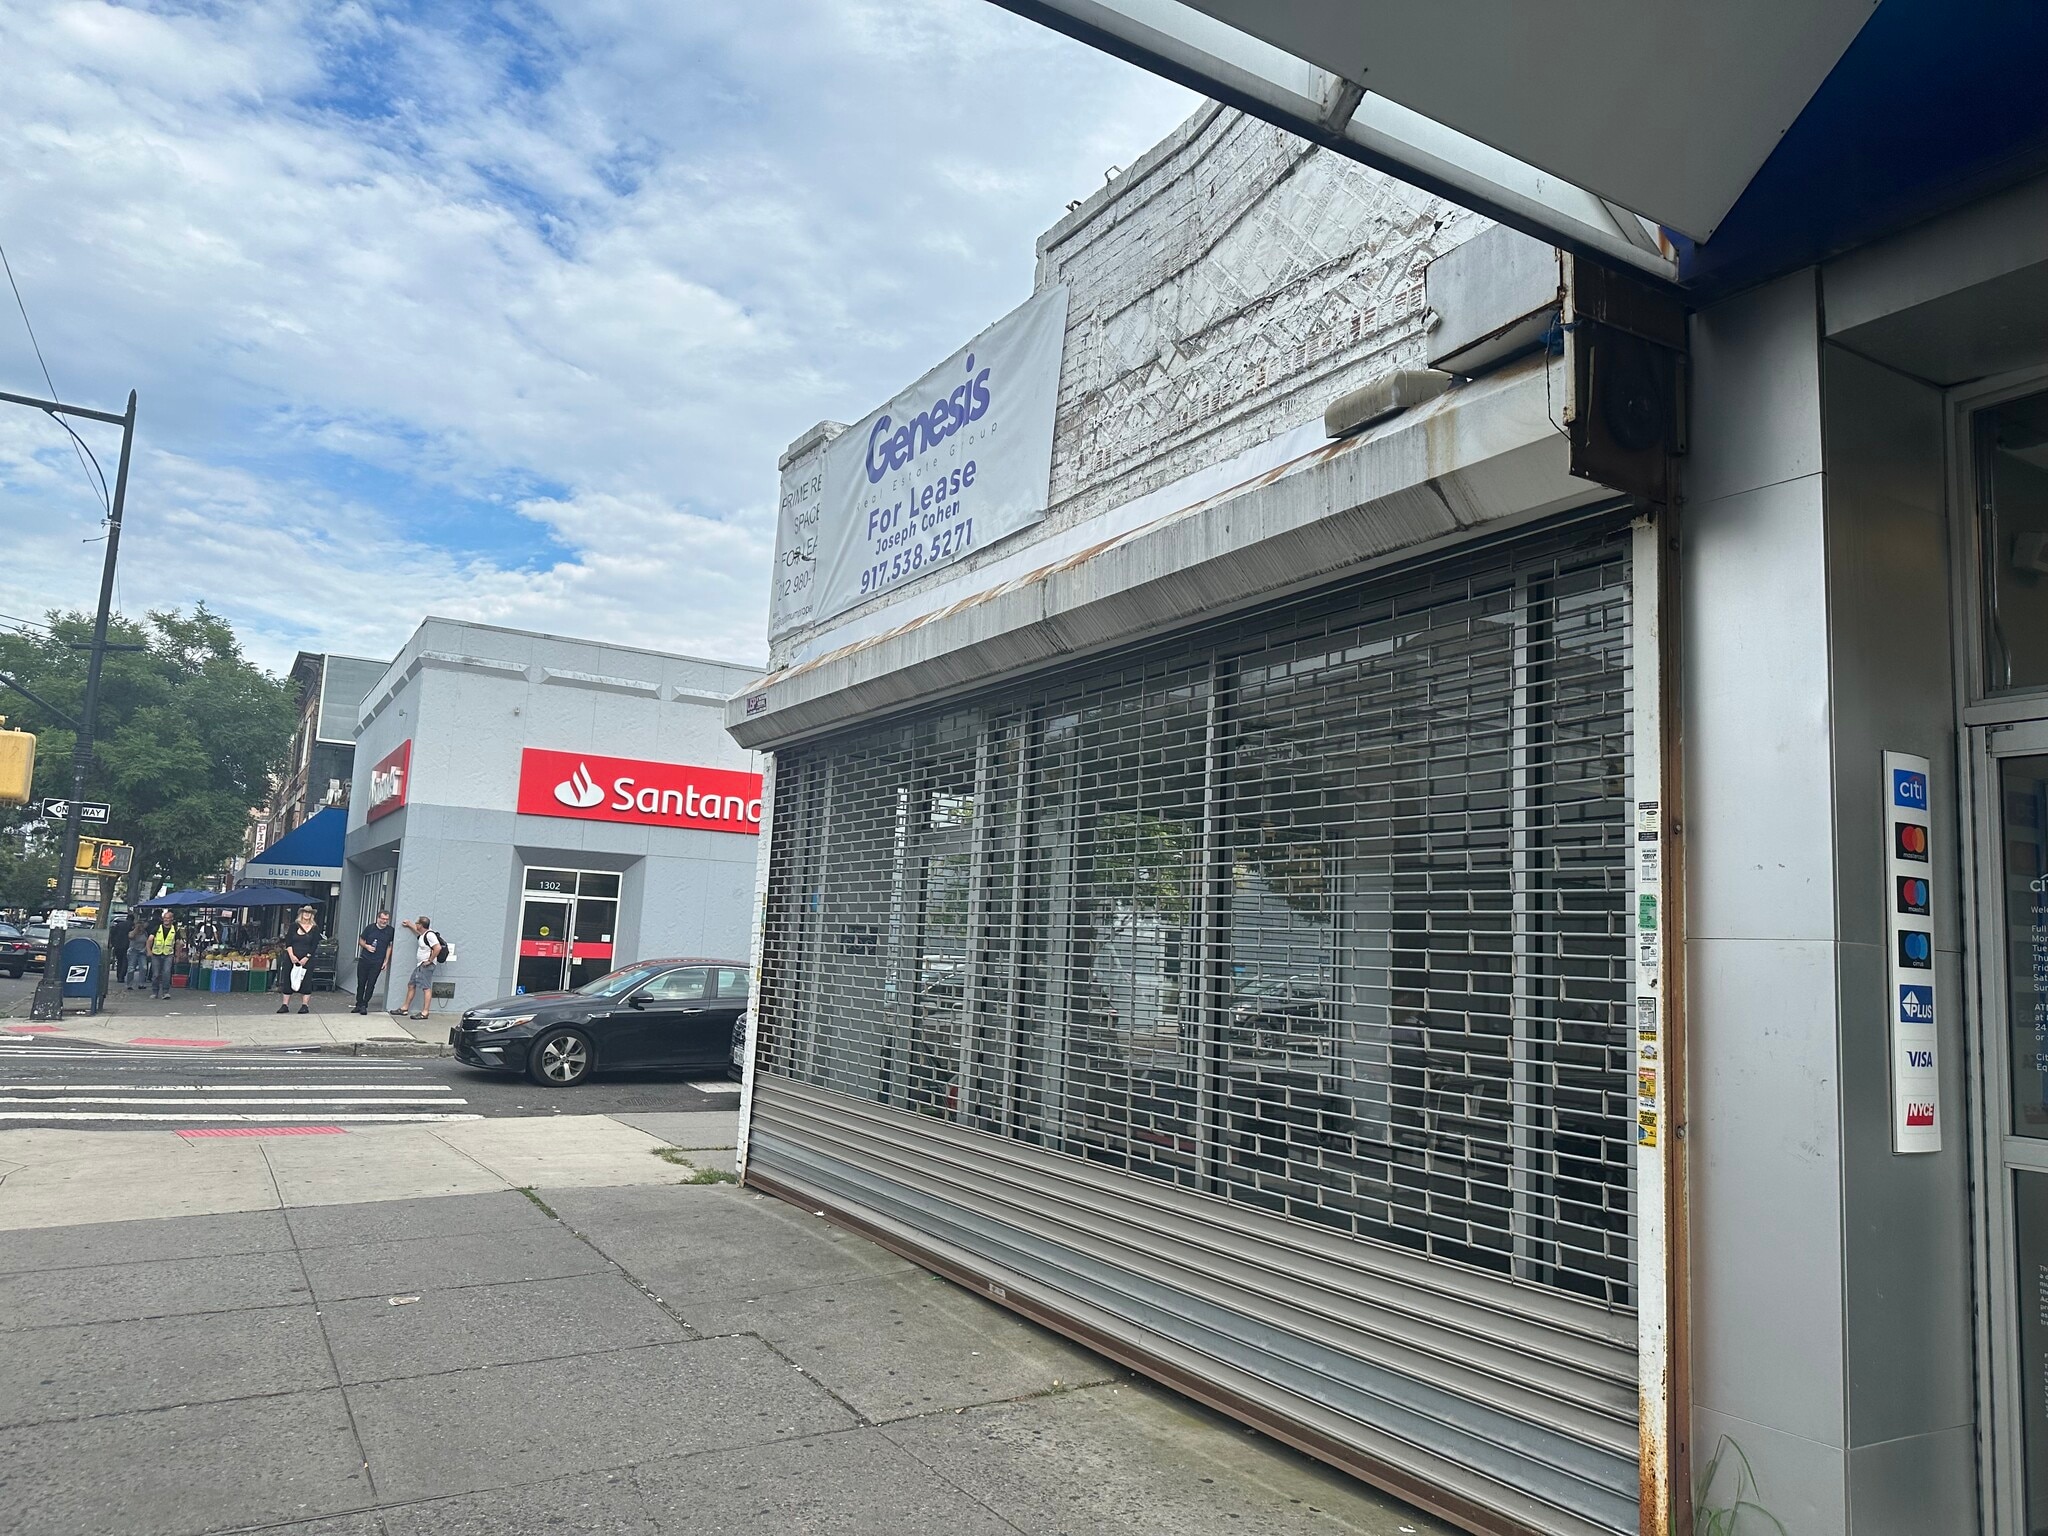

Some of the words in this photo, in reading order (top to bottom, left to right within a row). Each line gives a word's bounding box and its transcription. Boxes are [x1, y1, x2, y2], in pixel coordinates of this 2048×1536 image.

[866, 352, 991, 484] Genesis
[892, 458, 938, 492] Estate
[949, 421, 998, 457] Group
[781, 481, 809, 514] PRIME
[867, 501, 902, 541] For
[909, 460, 977, 519] Lease
[875, 520, 917, 556] Joseph
[921, 500, 960, 531] Cohen
[860, 517, 973, 595] 917.538.5271
[1900, 780, 1922, 800] citi
[82, 808, 101, 816] WAY
[268, 868, 289, 876] BLUE
[291, 869, 321, 878] RIBBON
[540, 881, 561, 890] 1302
[2032, 925, 2046, 933] Full
[2032, 944, 2047, 952] Tue
[1911, 1004, 1932, 1019] PLUS
[2035, 1023, 2047, 1031] 24
[1906, 1050, 1933, 1067] VISA
[1909, 1103, 1934, 1117] NYCE
